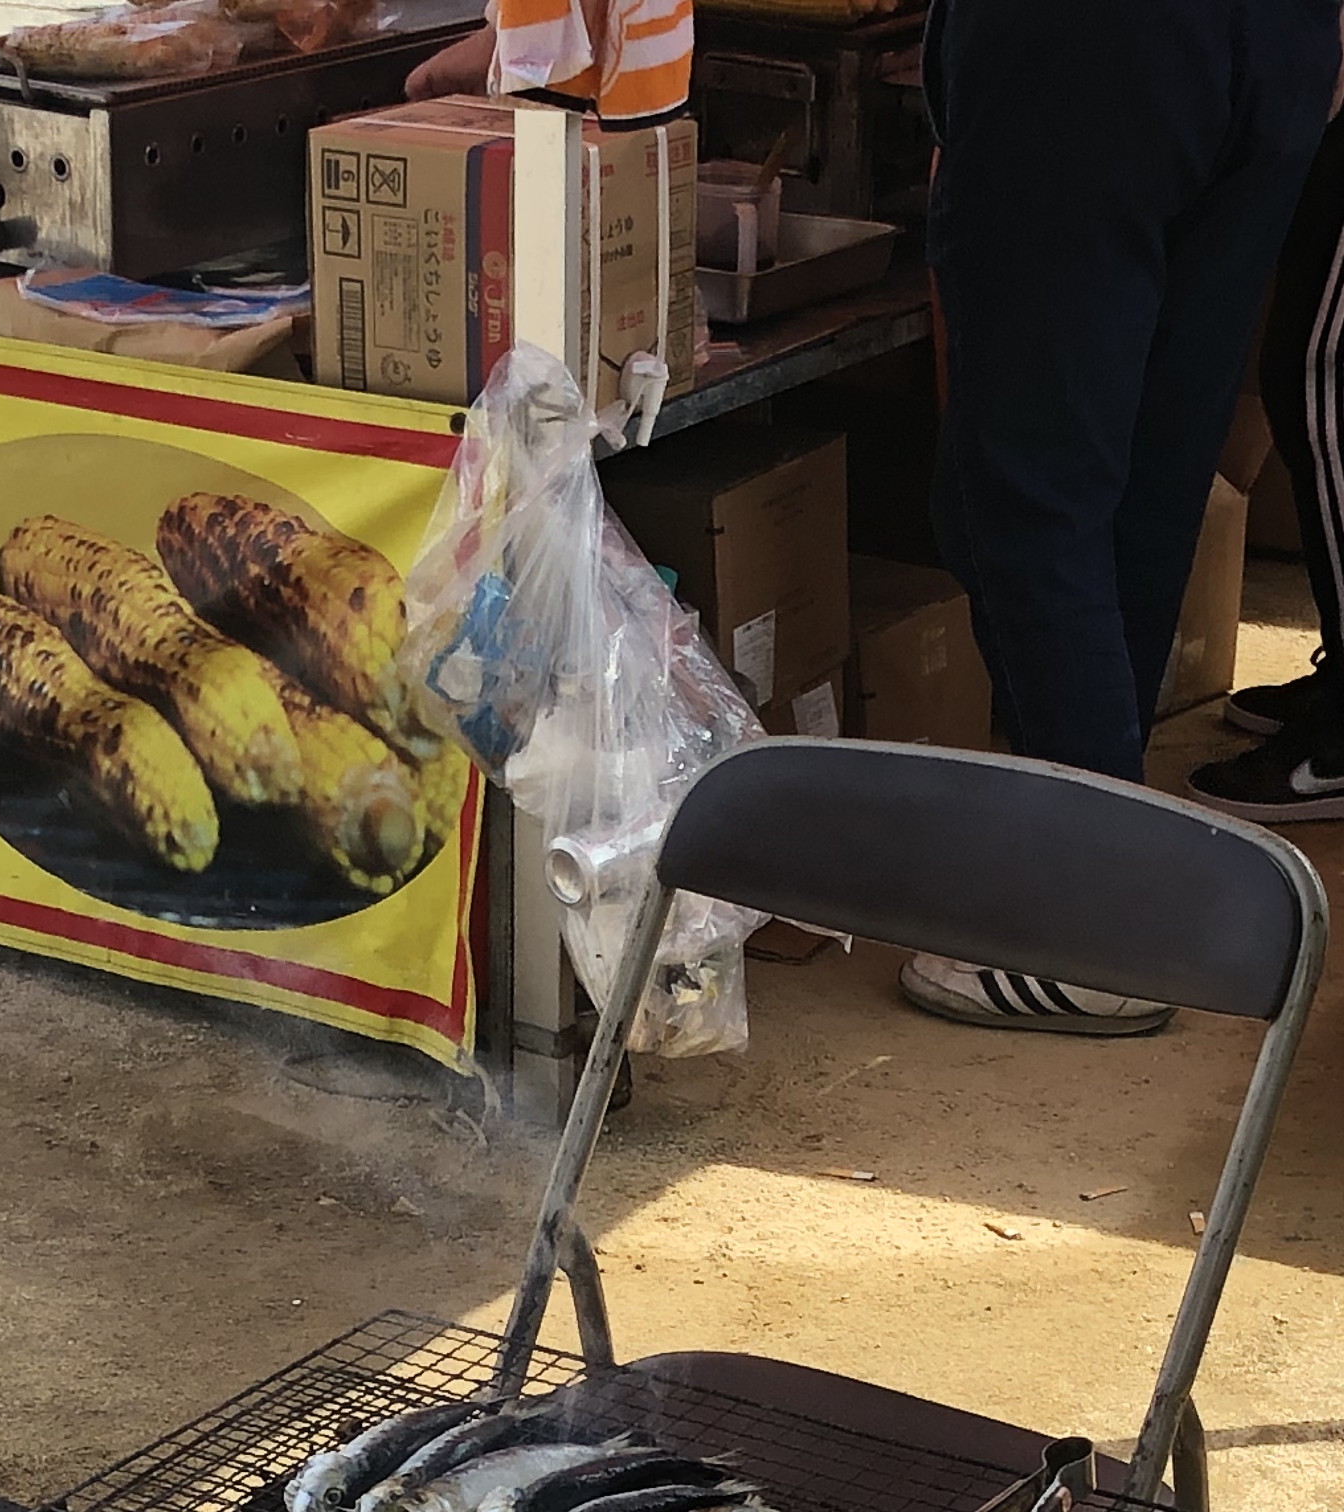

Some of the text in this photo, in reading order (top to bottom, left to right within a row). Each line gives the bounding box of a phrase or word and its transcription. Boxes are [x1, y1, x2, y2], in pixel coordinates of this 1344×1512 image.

[341, 169, 356, 183] 6
[422, 208, 442, 369] こいくちしょうゆ
